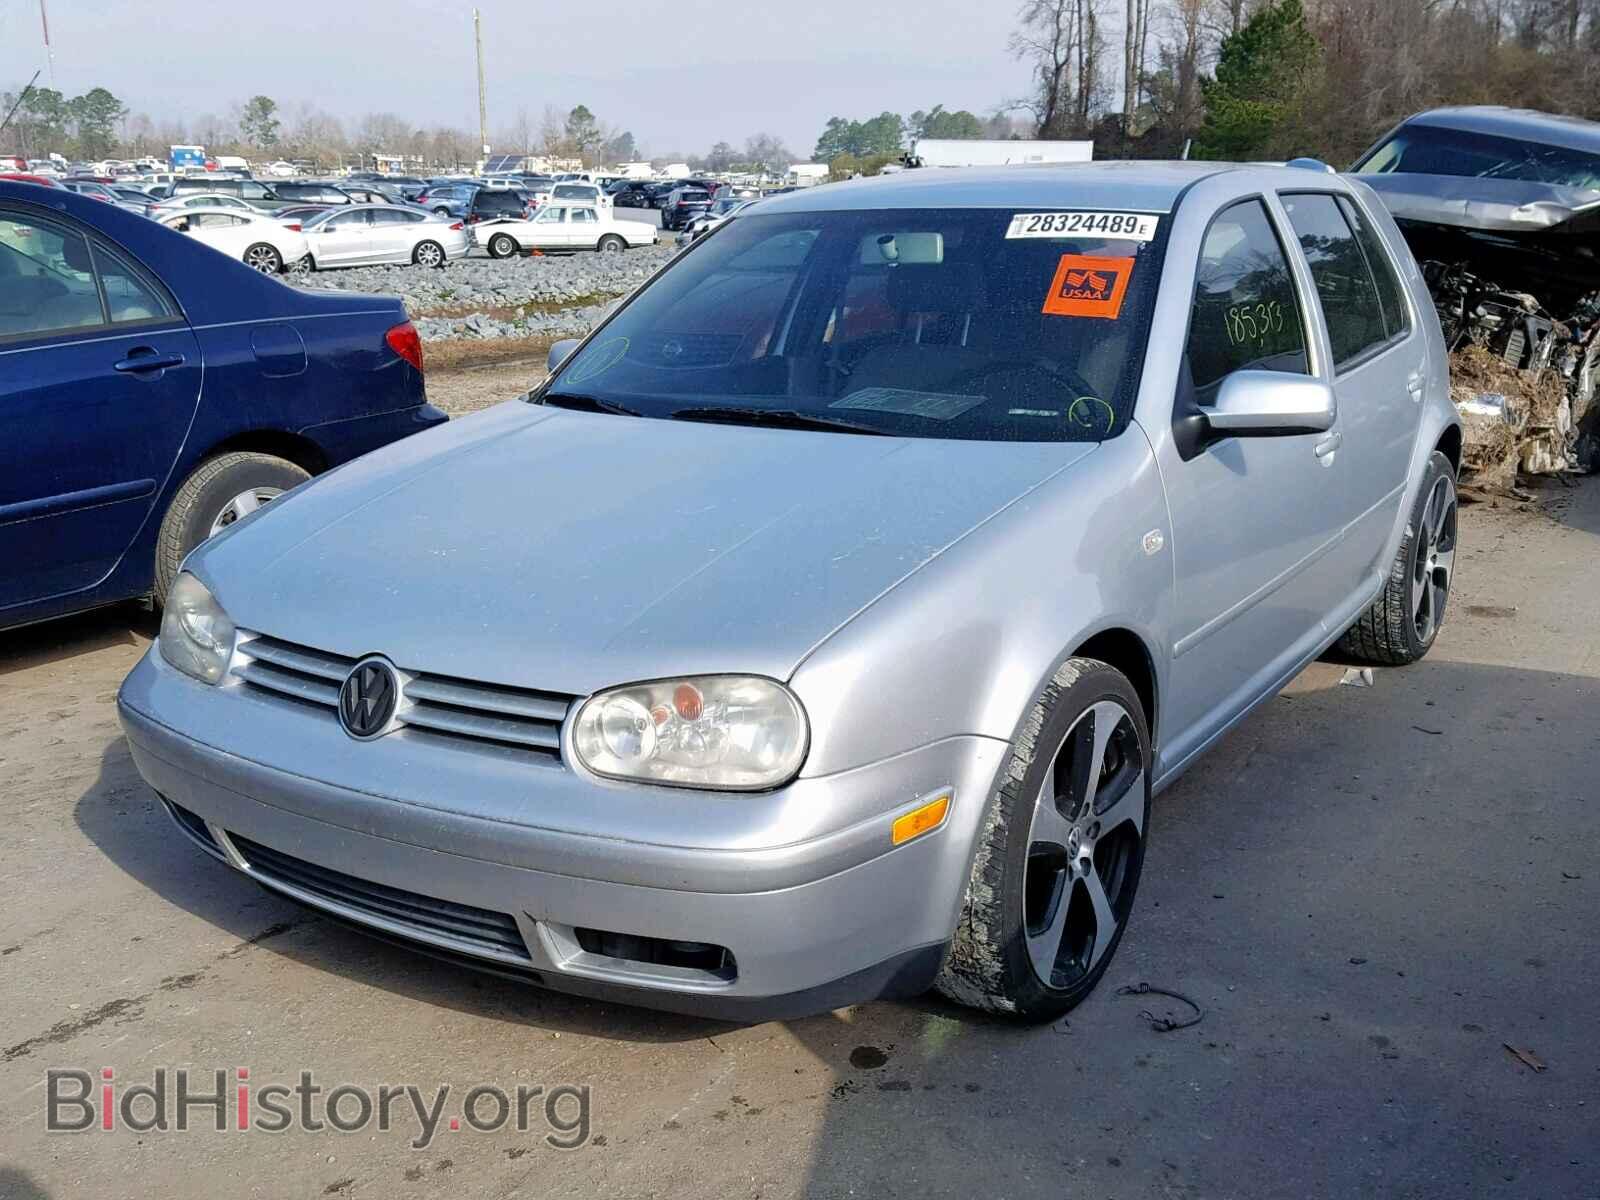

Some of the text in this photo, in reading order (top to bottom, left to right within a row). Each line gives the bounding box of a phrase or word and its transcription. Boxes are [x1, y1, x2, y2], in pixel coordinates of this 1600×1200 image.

[1027, 214, 1138, 234] 28324489
[1062, 288, 1103, 300] USAA
[342, 662, 396, 734] VW
